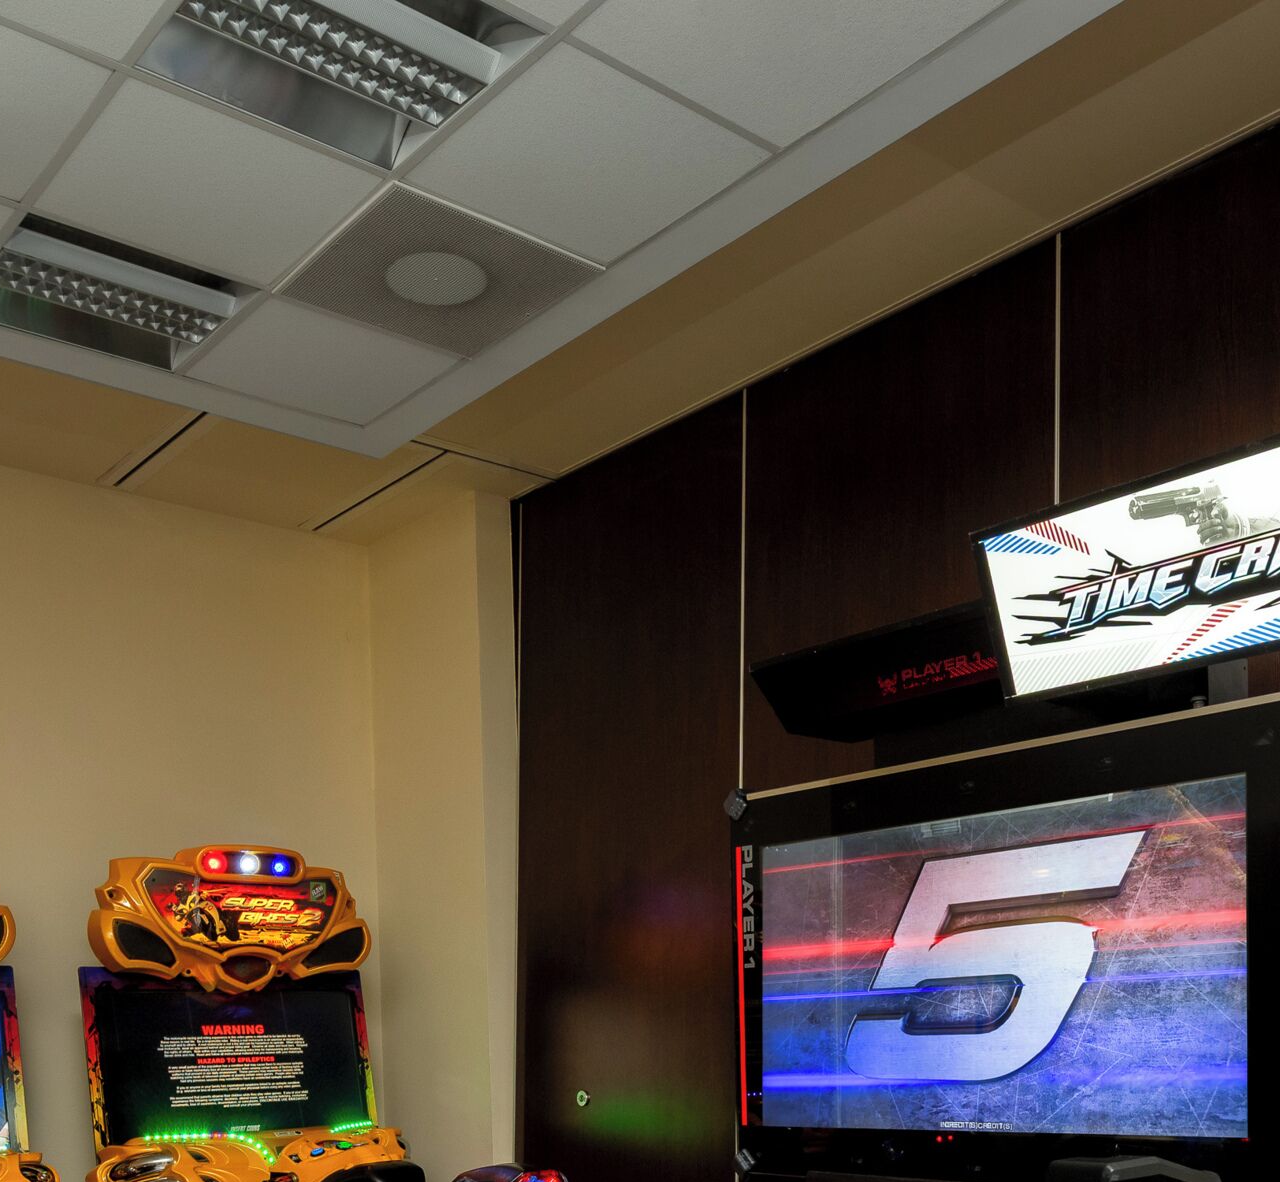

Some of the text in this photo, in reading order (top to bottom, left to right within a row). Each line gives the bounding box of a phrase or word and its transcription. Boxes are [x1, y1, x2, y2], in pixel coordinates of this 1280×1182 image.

[1063, 562, 1190, 626] TIME
[901, 655, 968, 680] PLAYER
[223, 897, 295, 911] SUPER
[741, 845, 755, 969] PLAYER 1
[238, 909, 322, 926] BIKES 2
[845, 828, 1152, 1083] 5
[201, 1024, 265, 1036] WARNING
[237, 1055, 275, 1064] EPILEPTICS
